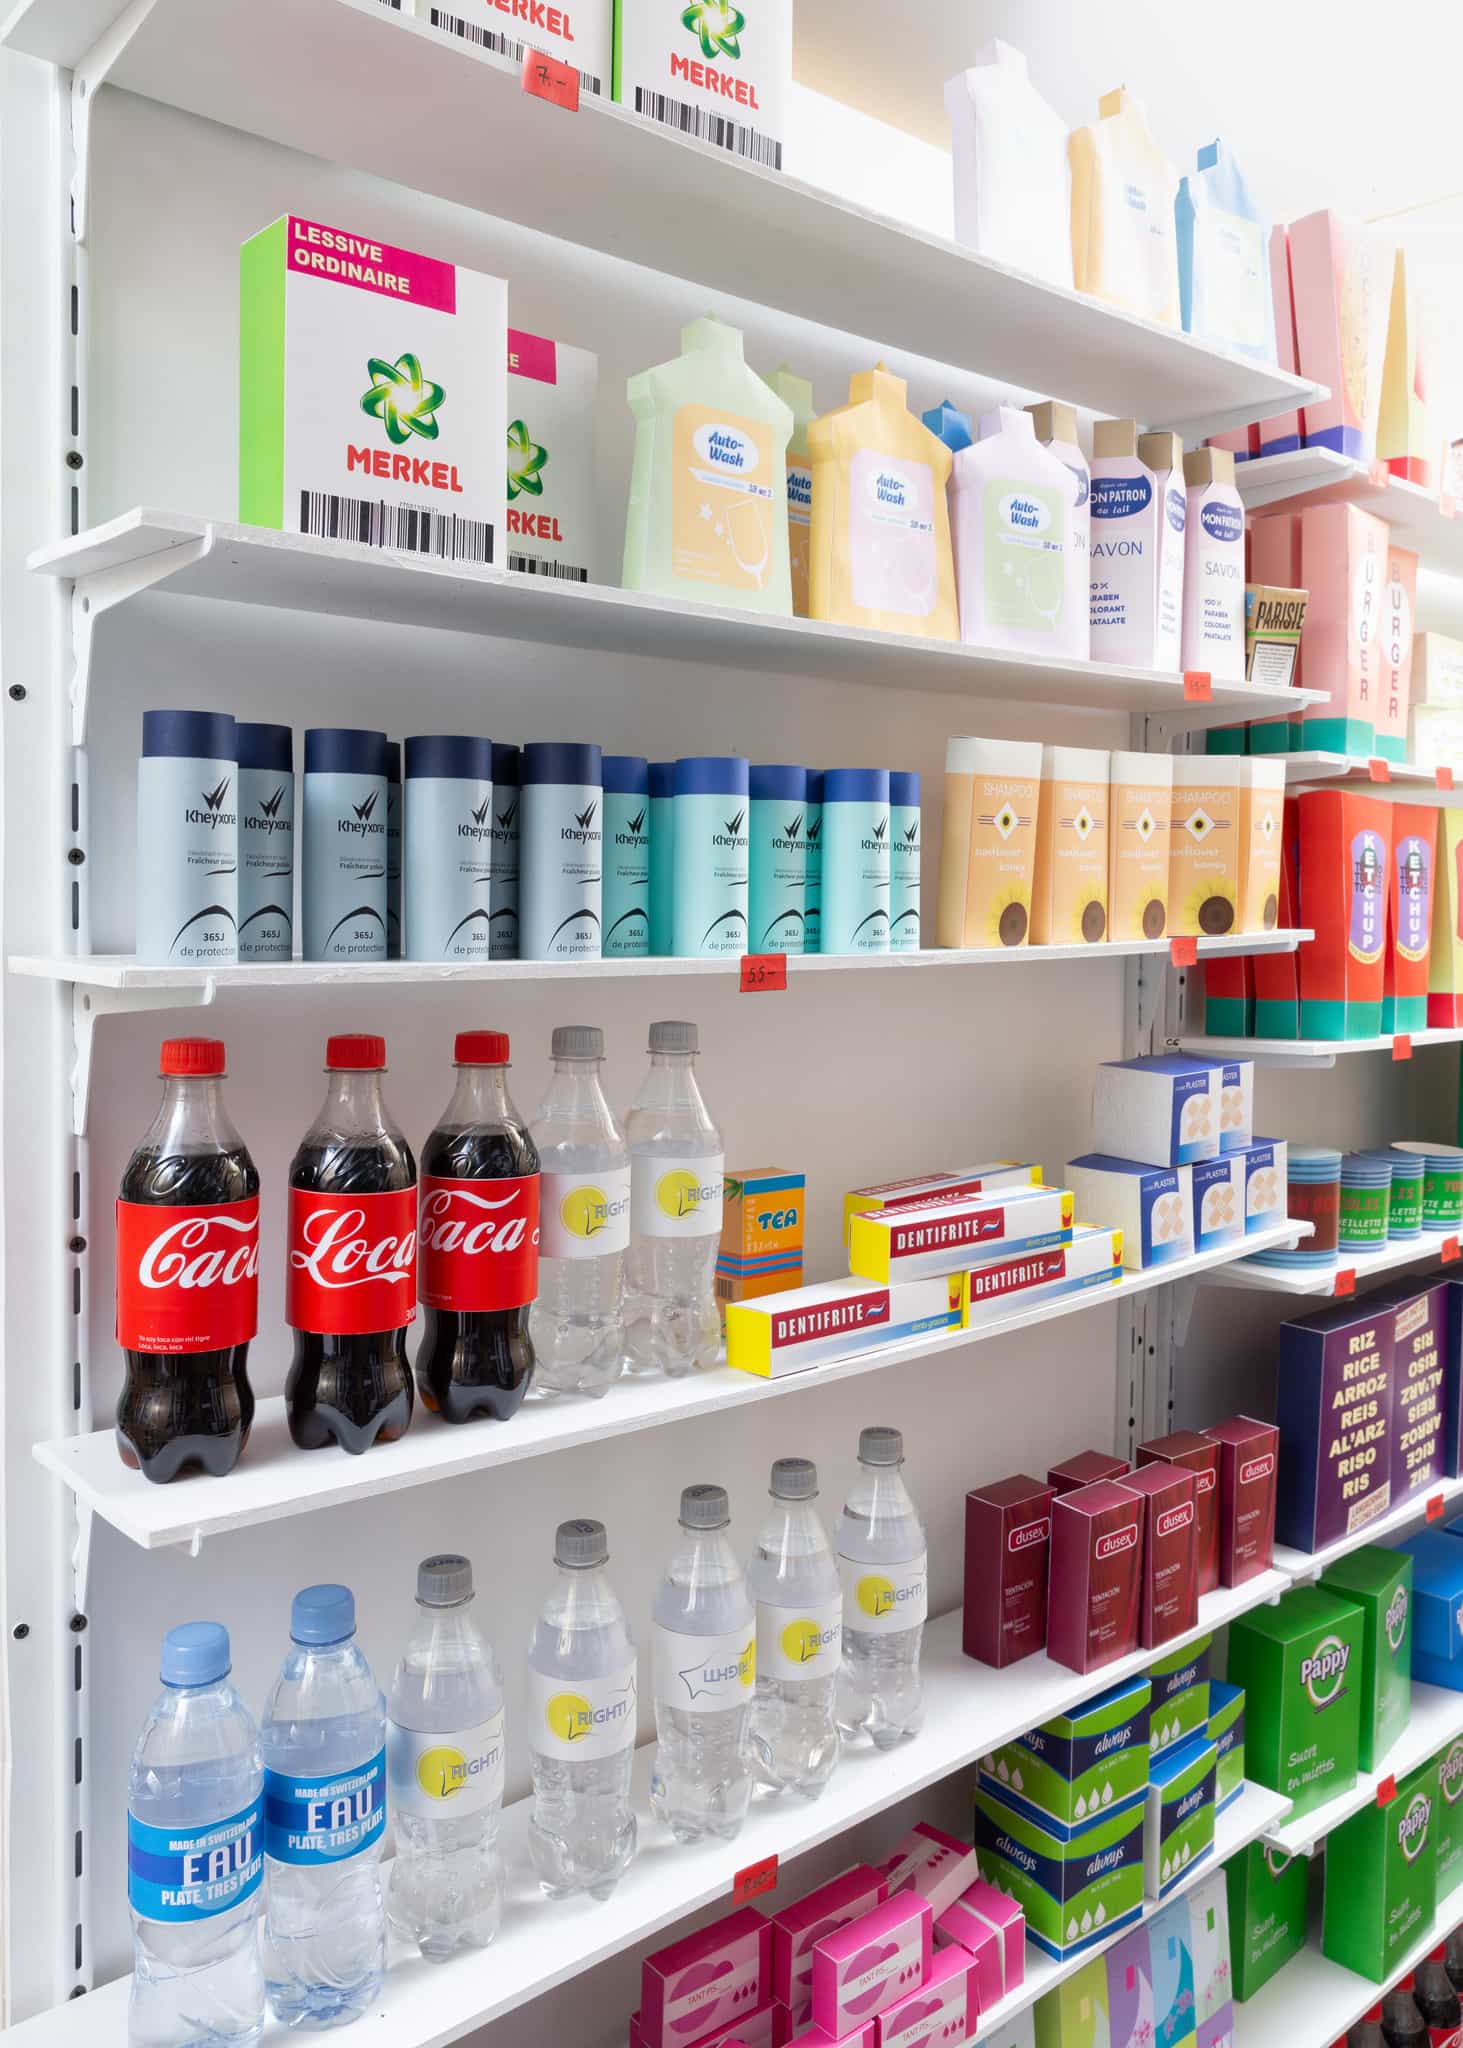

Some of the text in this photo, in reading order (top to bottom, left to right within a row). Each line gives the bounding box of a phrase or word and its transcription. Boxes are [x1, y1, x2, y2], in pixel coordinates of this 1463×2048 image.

[670, 52, 760, 111] MERKEL
[294, 222, 383, 263] LESSIVE
[294, 247, 410, 295] ORDINAIRE
[709, 431, 744, 449] Auto-
[347, 444, 463, 493] MERKEL
[709, 446, 744, 467] Wash
[876, 473, 904, 490] Auto-
[877, 488, 905, 506] Wash
[1010, 498, 1039, 514] Auto-
[1011, 511, 1039, 528] Wash
[1090, 540, 1143, 559] AVON
[1205, 561, 1241, 580] SAVON
[1388, 561, 1402, 719] BURGER
[1363, 834, 1375, 950] KETCHUP
[1408, 839, 1421, 948] KETCHUP
[203, 932, 225, 942] 365J
[261, 930, 280, 939] 365J
[334, 944, 345, 953] de
[354, 931, 373, 940] 365J
[181, 947, 193, 957] de
[1153, 1177, 1176, 1188] PLASTER
[1206, 1167, 1228, 1179] PLASTER
[757, 1207, 798, 1231] TEA
[898, 1219, 979, 1250] DENTIFRITE
[976, 1255, 1045, 1295] DENTIFRITE
[778, 1303, 864, 1340] DENTIFRITE
[1349, 1330, 1376, 1355] RIZ
[1413, 1330, 1434, 1354] RIS
[1343, 1352, 1380, 1381] RICE
[1408, 1350, 1438, 1379] RISO
[1332, 1373, 1387, 1409] ARROZ
[1341, 1400, 1378, 1430] REIS
[1408, 1394, 1436, 1423] REIS
[1329, 1419, 1386, 1458] AL'ARZ
[1400, 1412, 1442, 1451] ARROZ
[1338, 1447, 1376, 1478] RISO
[1407, 1438, 1435, 1470] RICE
[1246, 1463, 1270, 1479] dusex
[1410, 1463, 1431, 1490] RIZ
[1342, 1472, 1370, 1500] RIS
[1015, 1523, 1046, 1546] dusex
[1163, 1511, 1190, 1530] dusex
[1103, 1532, 1132, 1553] dusex
[1301, 1643, 1350, 1685] Pappy
[1167, 1666, 1198, 1694] always
[1094, 1725, 1132, 1756] always
[295, 1786, 320, 1799] MADE
[332, 1766, 379, 1796] SWITZERLAND
[307, 1784, 374, 1834] EAU
[1176, 1787, 1204, 1819] always
[169, 1839, 194, 1852] MADE
[207, 1812, 257, 1847] SWITZERLAND
[288, 1805, 384, 1850] PLATE TRES PLATE
[1398, 1798, 1432, 1844] Pappy
[183, 1831, 252, 1888] EAU
[996, 1836, 1038, 1871] always
[1086, 1845, 1125, 1877] always
[161, 1889, 202, 1907] PLATE
[206, 1880, 238, 1901] TRES
